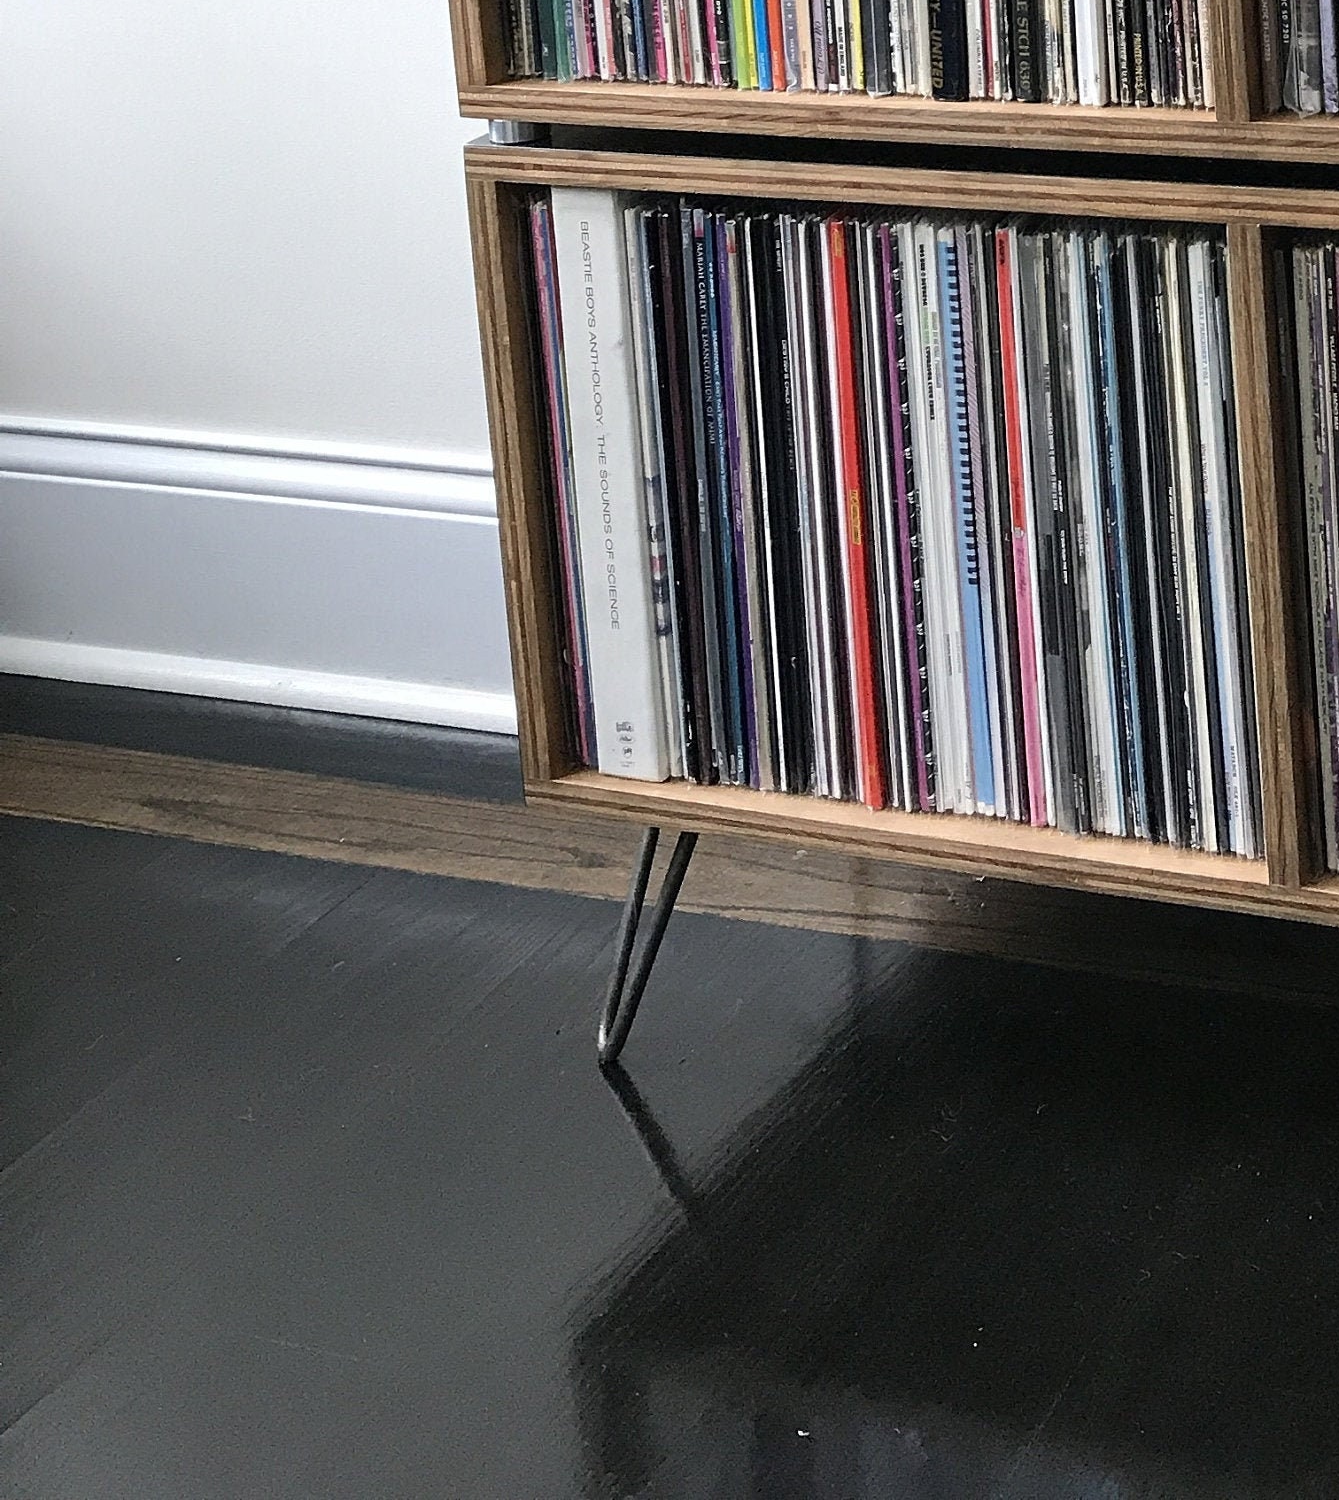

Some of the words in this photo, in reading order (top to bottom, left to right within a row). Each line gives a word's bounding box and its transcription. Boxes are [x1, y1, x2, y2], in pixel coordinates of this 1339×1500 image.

[578, 221, 592, 282] BEASTIE
[693, 242, 705, 278] MARIAH
[584, 287, 596, 327] BOYS
[696, 282, 706, 309] CAREY
[699, 313, 708, 329] THE
[699, 333, 713, 402] EMANCIPATION
[595, 435, 607, 466] THE
[706, 421, 715, 444] MIMI
[598, 469, 612, 533] SOUNDS
[603, 538, 614, 559] OF
[605, 564, 620, 629] SCIENCE
